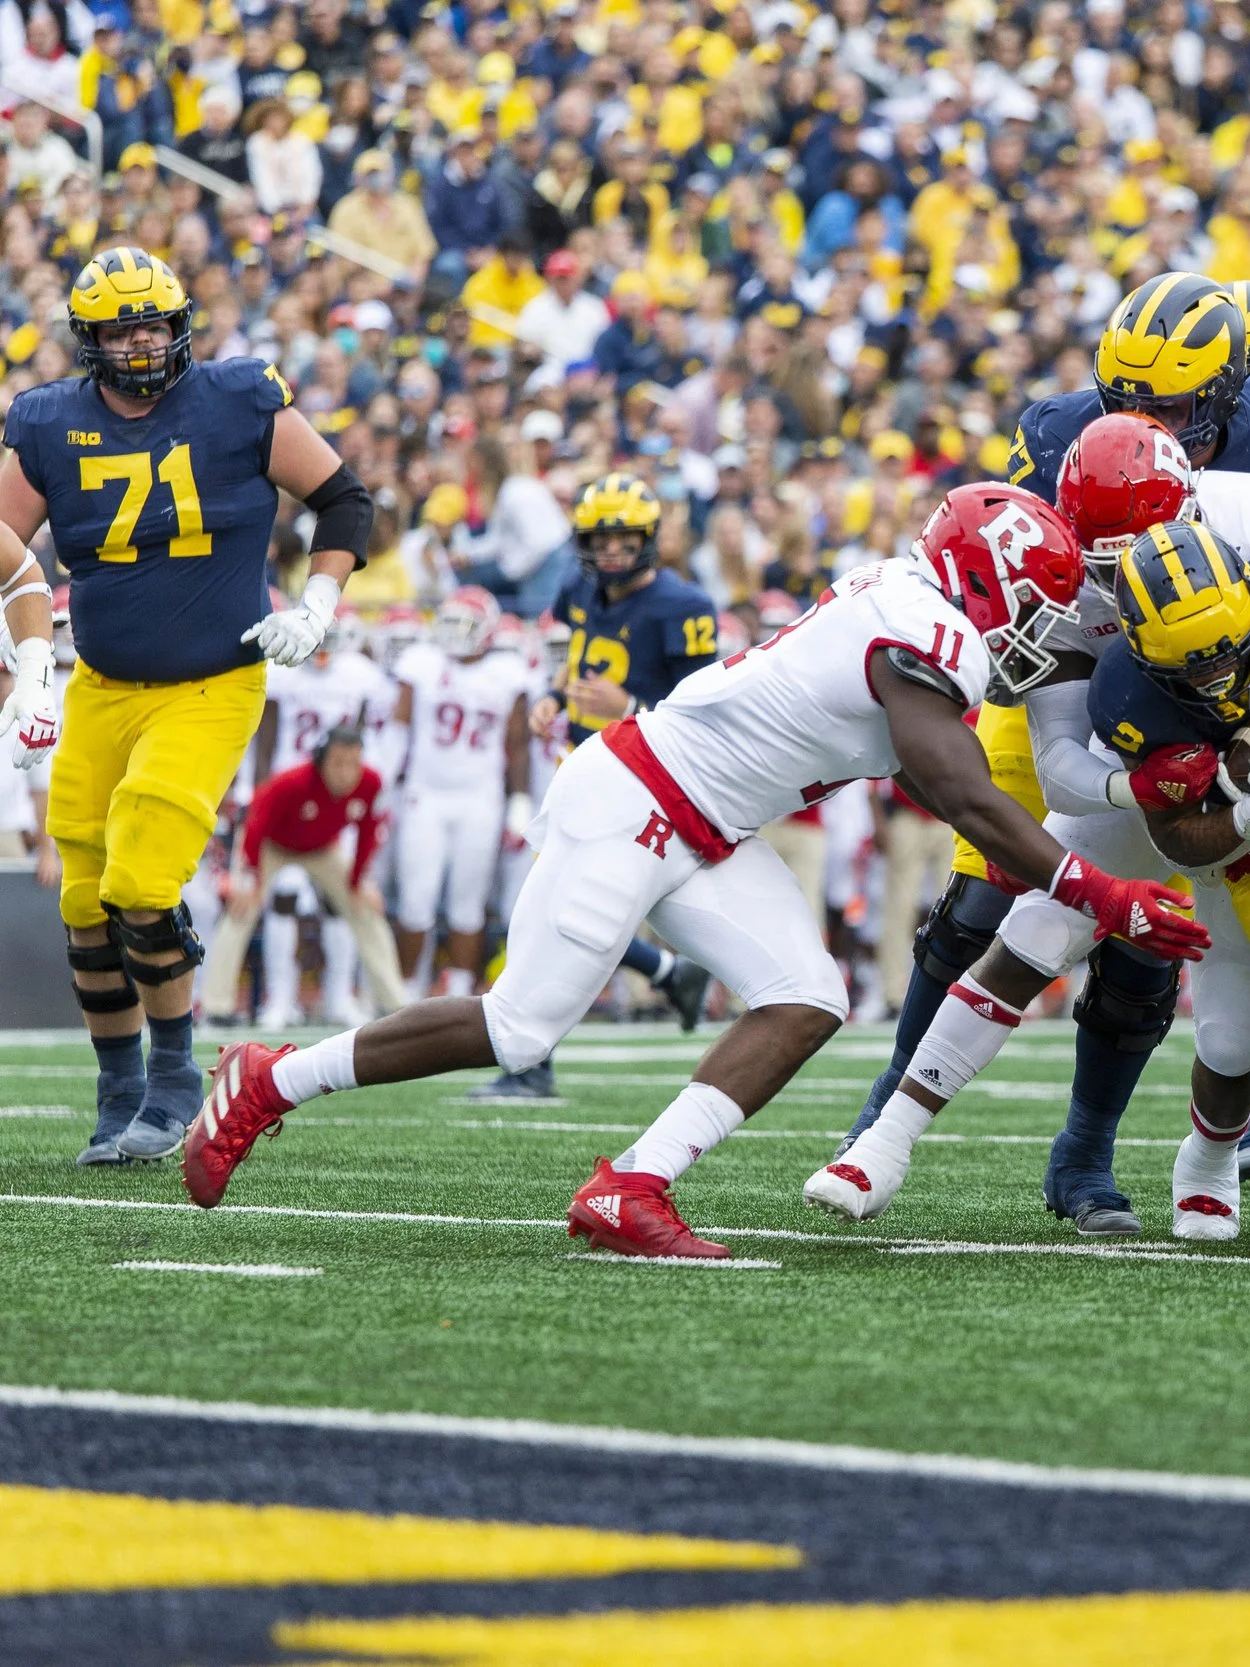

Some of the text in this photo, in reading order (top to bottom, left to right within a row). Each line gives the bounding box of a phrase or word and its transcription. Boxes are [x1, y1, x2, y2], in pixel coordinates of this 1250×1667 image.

[79, 443, 213, 563] 71
[978, 502, 1045, 571] R
[683, 616, 716, 656] 12
[927, 622, 965, 673] 11
[435, 703, 496, 751] 92
[635, 810, 674, 859] R
[1129, 901, 1140, 938] adidas
[918, 1069, 942, 1087] adidas
[586, 1198, 621, 1228] adidas
